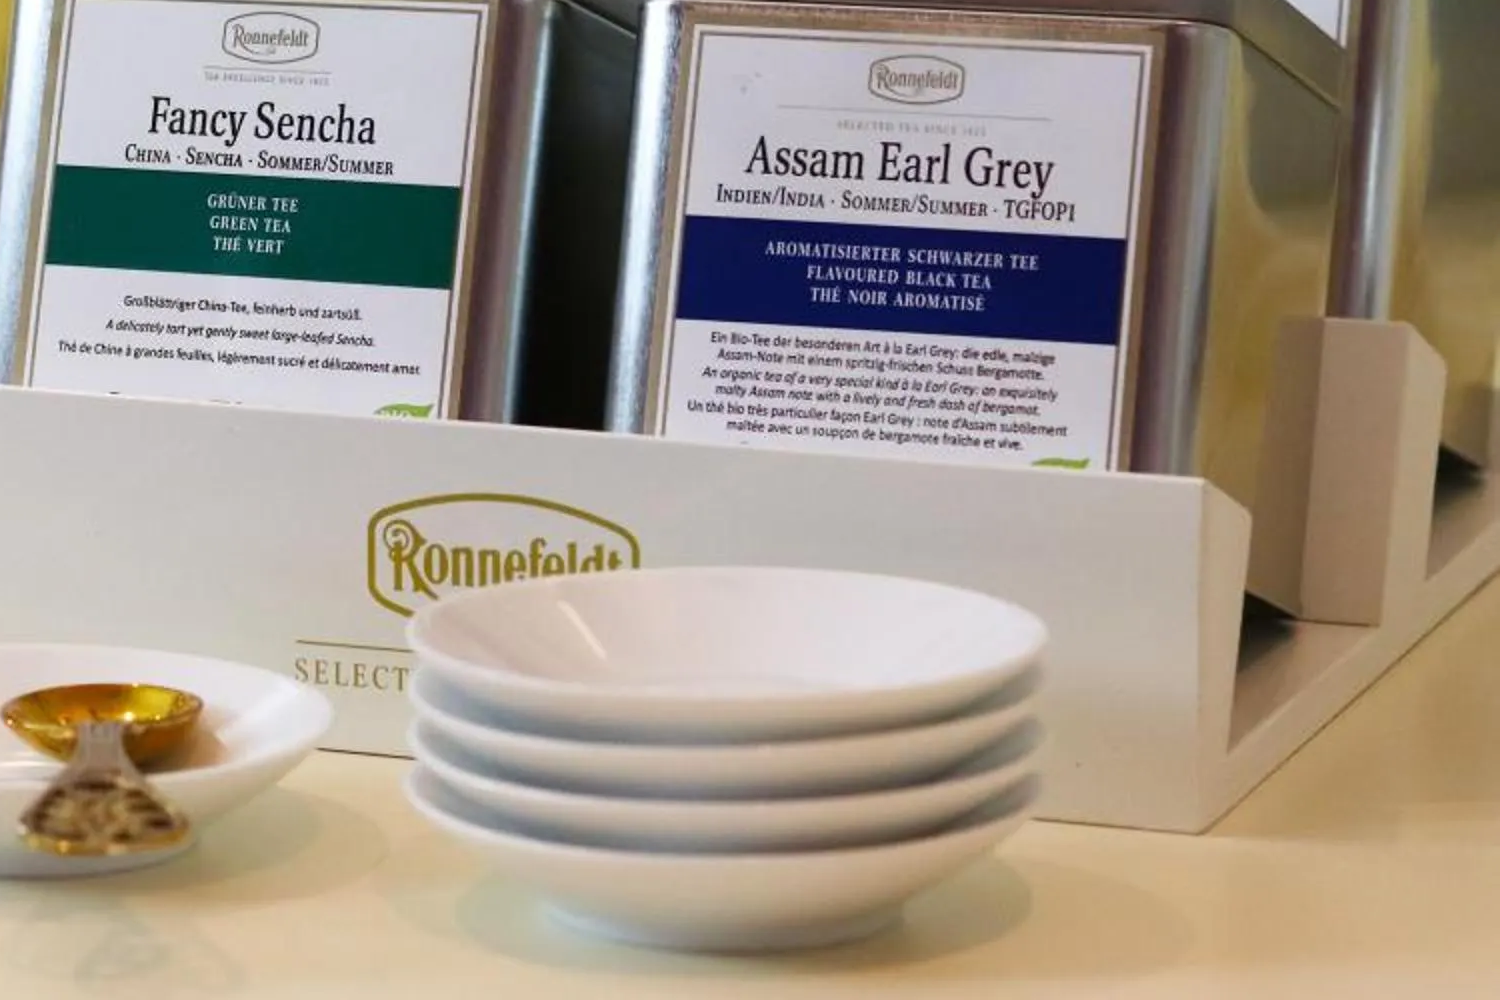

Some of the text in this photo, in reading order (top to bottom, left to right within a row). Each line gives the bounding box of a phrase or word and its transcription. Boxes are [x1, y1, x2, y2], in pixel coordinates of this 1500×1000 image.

[232, 24, 308, 50] Ronnefeldt
[875, 63, 959, 94] Ronnefeldt
[148, 95, 376, 147] Fancy Sencha
[744, 135, 1055, 200] Assam Earl Grey
[207, 191, 299, 213] GRÜNER TEE
[209, 215, 291, 233] GREEN TEA
[247, 238, 285, 255] VERT
[765, 240, 1039, 271] AROMATISIERTER SCHWARZER TEE
[807, 264, 992, 290] FLAVOURED BLACK TEA
[298, 306, 319, 318] und
[810, 285, 986, 312] THÉ NOIR AROMATISÉ
[106, 319, 114, 330] A
[115, 319, 165, 335] delicately
[166, 323, 185, 334] tart
[187, 325, 204, 337] yet
[205, 326, 237, 341] gently
[238, 329, 270, 341] sweet
[271, 329, 335, 348] large-leafed
[711, 331, 727, 343] Ein
[730, 332, 771, 347] Bio-Tee
[773, 335, 791, 347] der
[795, 336, 860, 352] besonderen
[863, 341, 881, 353] Art
[884, 341, 890, 354] à
[893, 341, 902, 354] la
[905, 343, 926, 356] Earl
[962, 347, 980, 359] die
[717, 347, 784, 363] Assam-Note
[787, 353, 804, 365] mit
[807, 354, 842, 367] einem
[937, 361, 973, 376] Schuss
[702, 366, 717, 377] An
[720, 369, 762, 382] organic
[764, 371, 782, 382] tea
[784, 371, 798, 384] of
[798, 374, 806, 384] a
[809, 375, 832, 388] very
[835, 376, 874, 389] special
[875, 377, 900, 391] kind
[911, 380, 922, 391] la
[924, 380, 948, 393] Earl
[981, 386, 996, 396] an
[998, 387, 1059, 402] exquisitely
[687, 400, 703, 412] Un
[706, 400, 724, 413] thé
[727, 402, 744, 414] bio
[748, 404, 768, 417] très
[771, 405, 828, 419] particulier
[829, 408, 861, 424] façon
[864, 411, 885, 423] Earl
[923, 417, 949, 429] note
[715, 385, 746, 398] malty
[749, 386, 785, 398] Assam
[788, 389, 813, 401] note
[816, 390, 841, 401] with
[843, 393, 851, 403] a
[853, 392, 881, 408] lively
[884, 395, 907, 407] and
[906, 395, 937, 410] fresh
[939, 398, 965, 411] dash
[967, 401, 981, 415] of
[727, 420, 764, 432] maltée
[768, 423, 793, 435] avec
[796, 425, 810, 435] un
[812, 427, 859, 441] soupçon
[862, 428, 876, 440] de
[879, 428, 939, 445] bergamote
[983, 438, 995, 449] et
